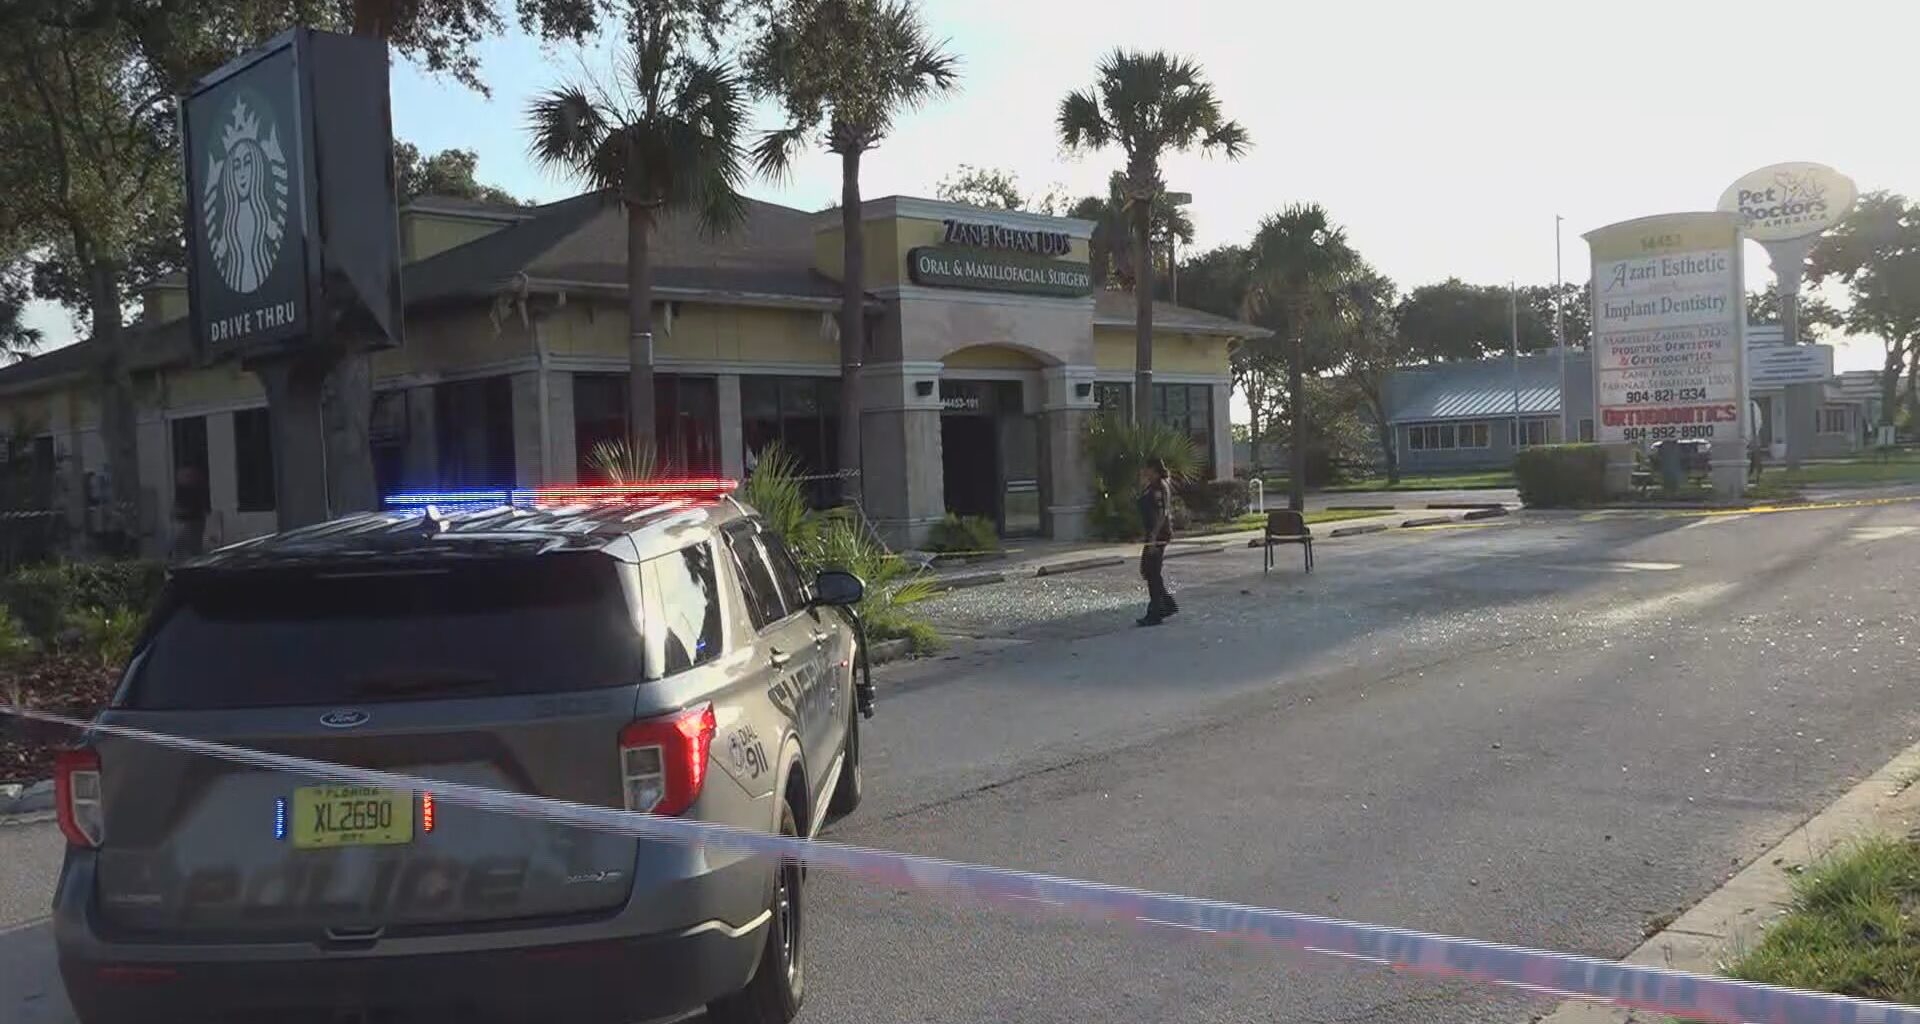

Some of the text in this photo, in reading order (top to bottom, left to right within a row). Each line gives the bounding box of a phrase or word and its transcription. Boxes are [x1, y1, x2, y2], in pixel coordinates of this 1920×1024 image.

[1738, 188, 1776, 206] Pet
[1739, 201, 1827, 220] Doctors
[1764, 213, 1828, 228] AMERICA
[920, 256, 1090, 288] ORAL & MAXILLOFACIAL SURGERY
[1605, 252, 1727, 292] Azari Esthetic
[1604, 294, 1727, 321] Implant Dentistry
[211, 301, 295, 341] DRIVE THRU
[1665, 340, 1722, 352] DENTISTRY
[1631, 352, 1713, 366] ORTHODONTICS
[1623, 424, 1714, 441] 904-992-8900
[328, 709, 360, 723] Ford
[745, 741, 769, 779] 911
[314, 800, 392, 833] XL2690
